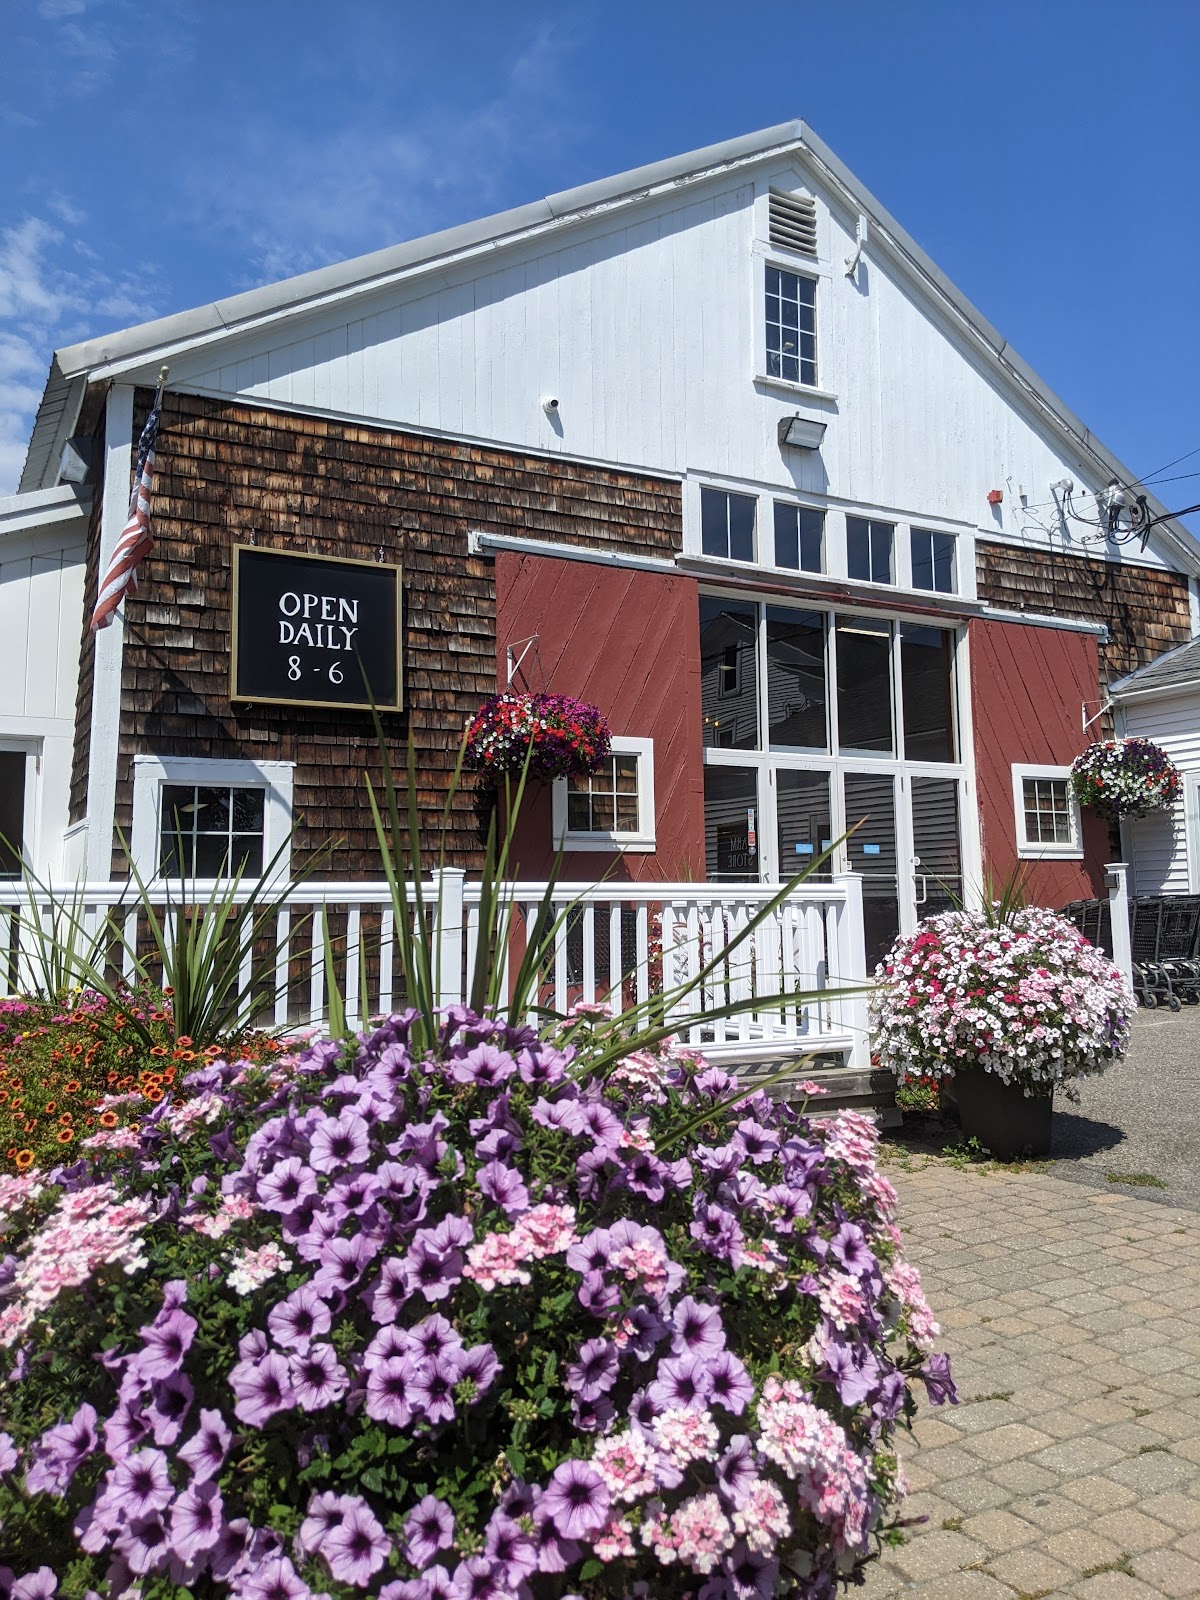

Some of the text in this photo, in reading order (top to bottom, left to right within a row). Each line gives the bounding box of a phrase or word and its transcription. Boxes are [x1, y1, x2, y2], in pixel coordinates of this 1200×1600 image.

[278, 591, 360, 624] OPEN
[278, 620, 359, 651] DAILY
[287, 655, 302, 681] 8
[328, 661, 344, 684] 6
